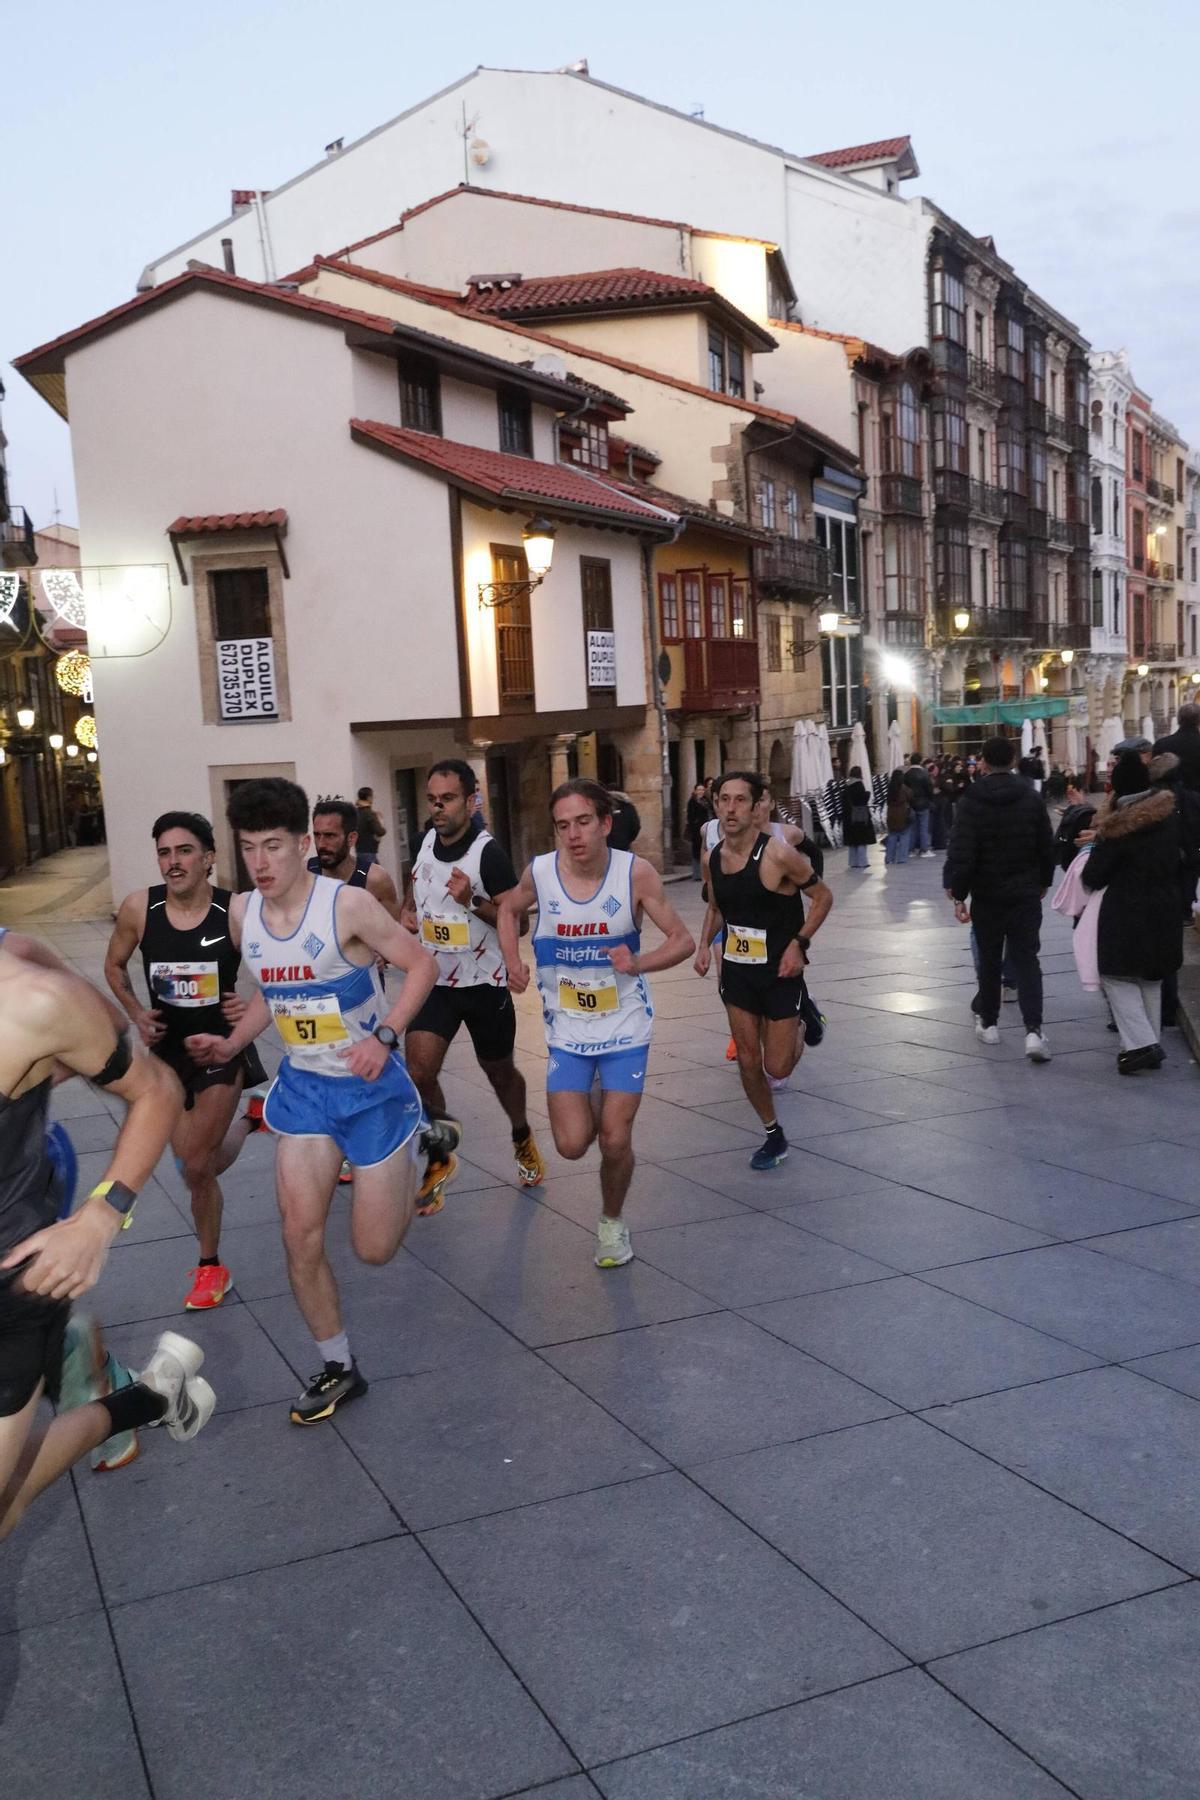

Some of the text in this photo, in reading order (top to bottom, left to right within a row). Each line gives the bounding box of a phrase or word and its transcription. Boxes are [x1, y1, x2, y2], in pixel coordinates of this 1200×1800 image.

[220, 643, 243, 714] 673 735 370
[240, 644, 258, 711] DUPLEX
[256, 641, 274, 712] ALQUILO
[434, 925, 450, 941] 59
[557, 922, 610, 937] BIKILA
[555, 945, 612, 962] atlétic
[736, 938, 750, 953] 29
[260, 965, 317, 983] BIKILA
[172, 980, 199, 996] 100
[577, 991, 597, 1009] 50
[295, 1019, 317, 1040] 57
